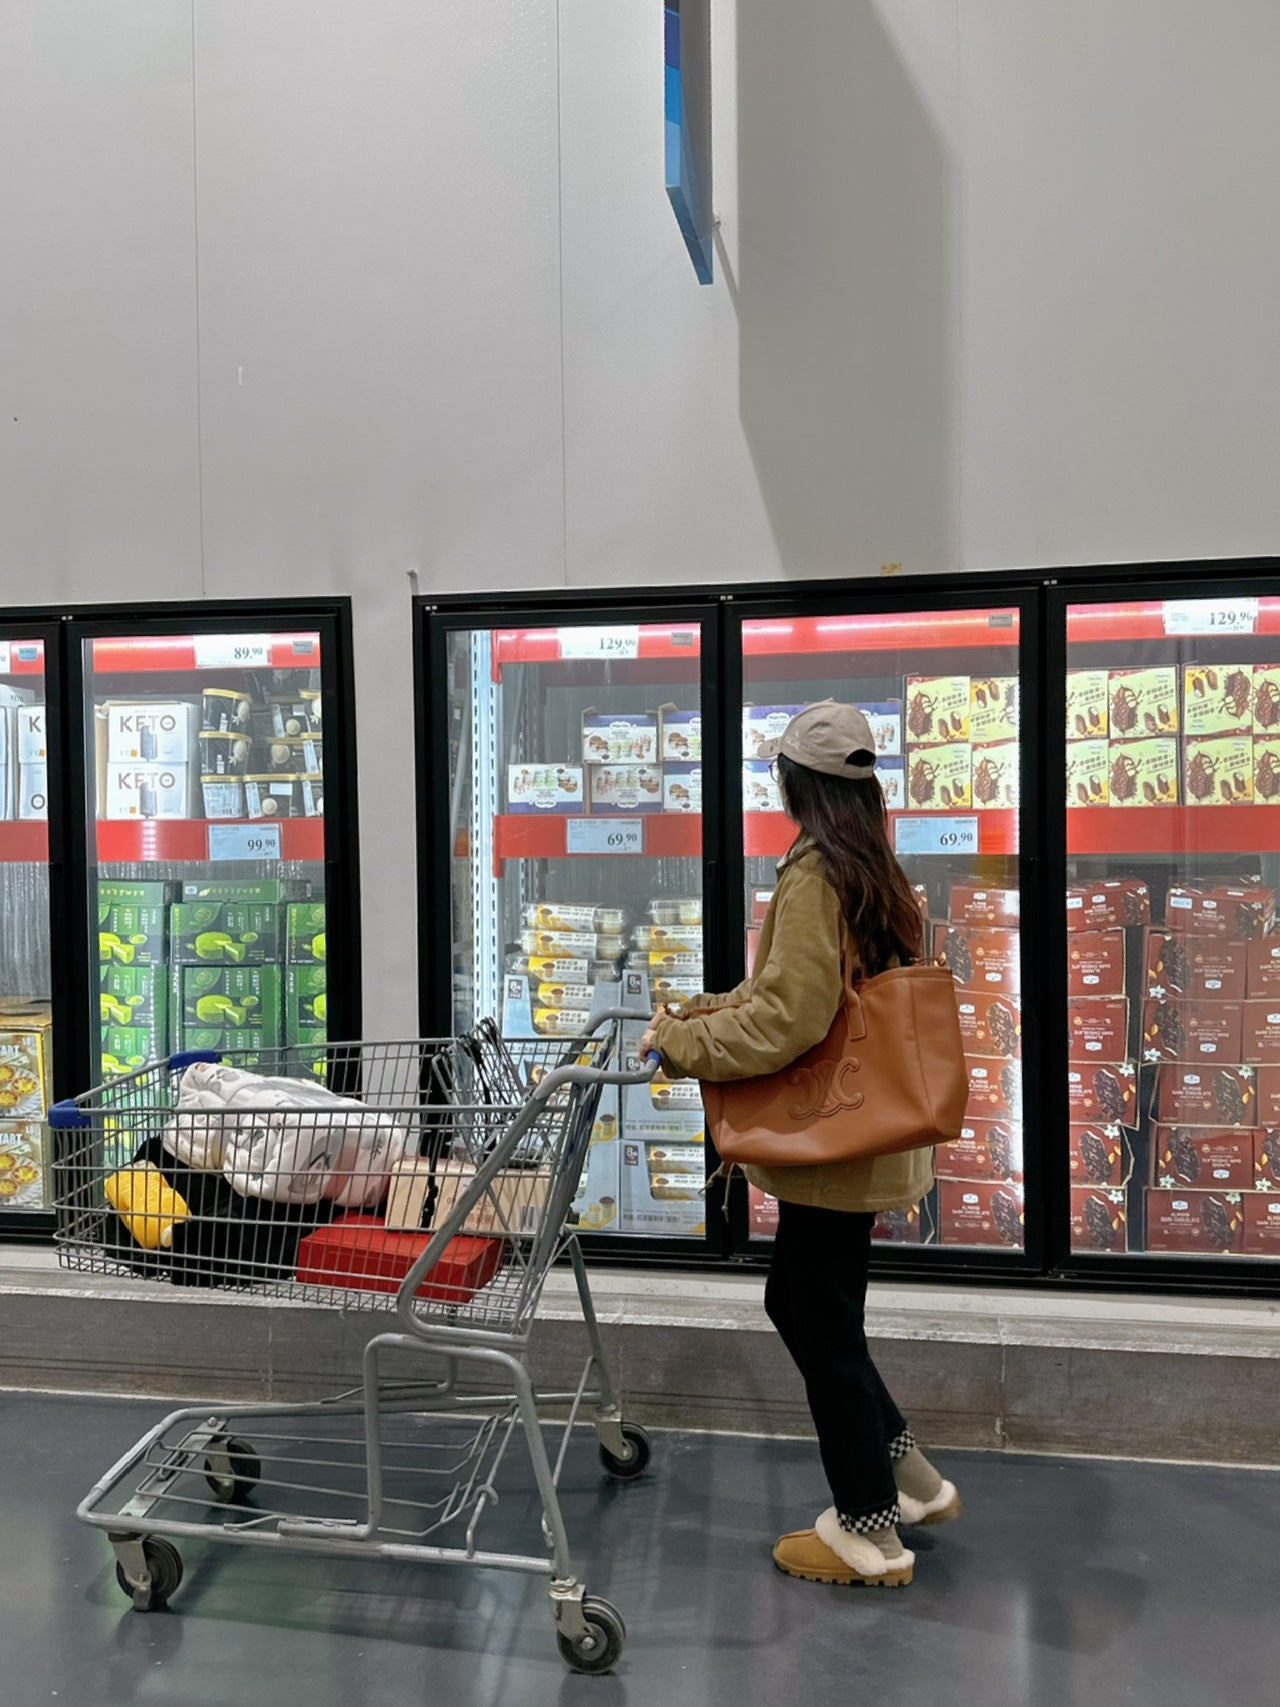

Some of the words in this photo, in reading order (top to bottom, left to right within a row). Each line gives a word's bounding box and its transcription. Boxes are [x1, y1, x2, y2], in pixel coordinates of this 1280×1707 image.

[234, 647, 263, 660] 89.90
[120, 715, 176, 732] KETO
[118, 772, 176, 790] KETO
[247, 839, 276, 852] 99.90
[607, 833, 637, 846] 69.90
[940, 833, 973, 847] 69.90
[0, 1045, 19, 1057] ART
